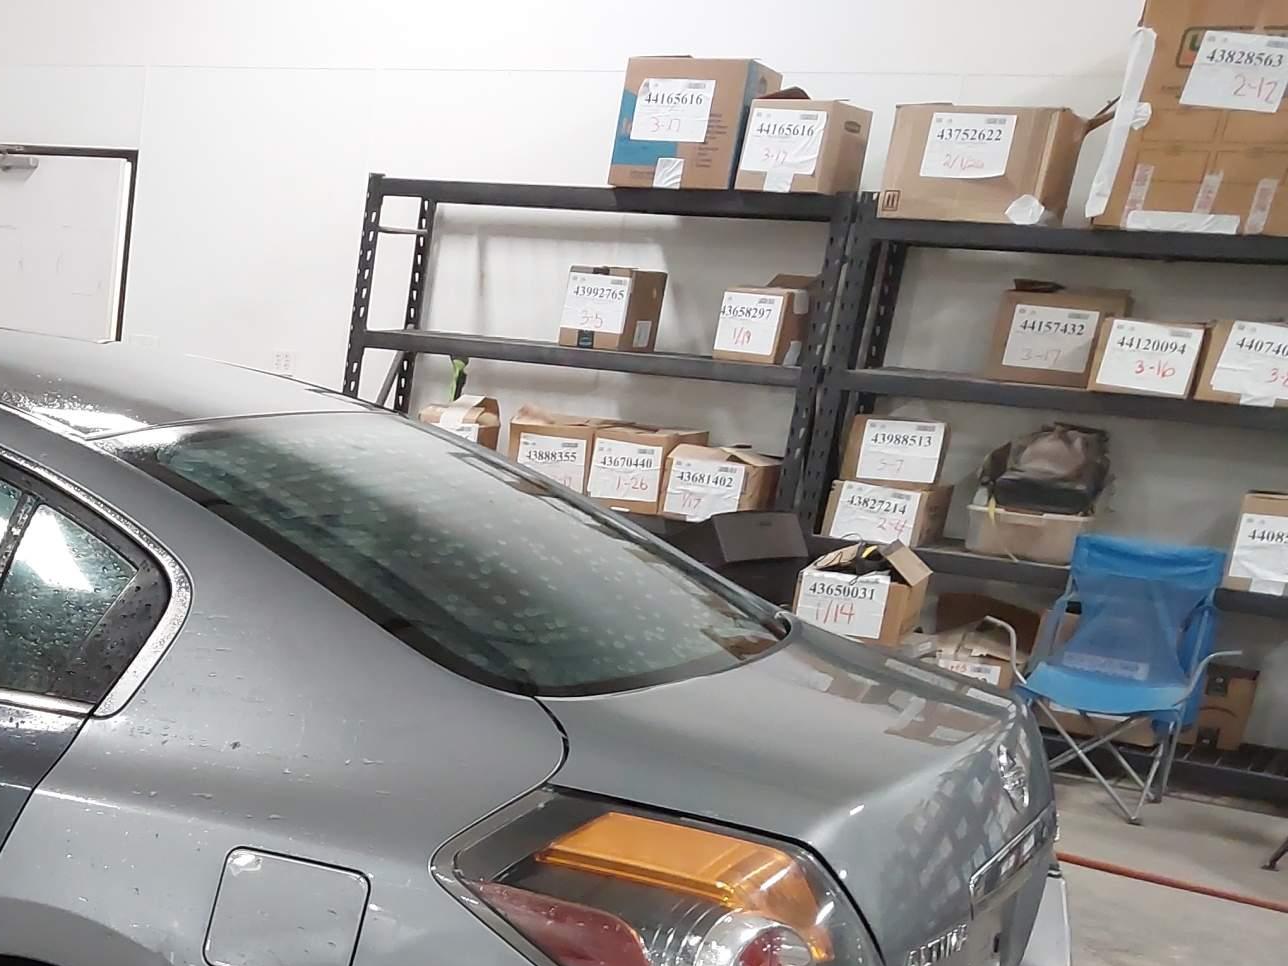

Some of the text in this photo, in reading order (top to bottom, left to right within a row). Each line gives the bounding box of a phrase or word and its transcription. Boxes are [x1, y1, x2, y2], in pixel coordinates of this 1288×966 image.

[1206, 48, 1283, 68] 43828563
[644, 93, 703, 105] 44165616
[756, 122, 815, 137] 44165616
[937, 128, 1002, 141] 43752622
[573, 286, 625, 300] 43992765
[720, 304, 772, 320] 43658297
[1020, 320, 1085, 336] 44157432
[1117, 336, 1187, 355] 44120094
[1134, 359, 1175, 378] 3-16
[871, 433, 932, 448] 43988513
[526, 450, 577, 463] 43888355
[600, 456, 653, 469] 43670440
[616, 474, 648, 491] 1-26
[677, 473, 734, 488] 43681402
[847, 495, 907, 515] 43827214
[809, 582, 875, 600] 43650031
